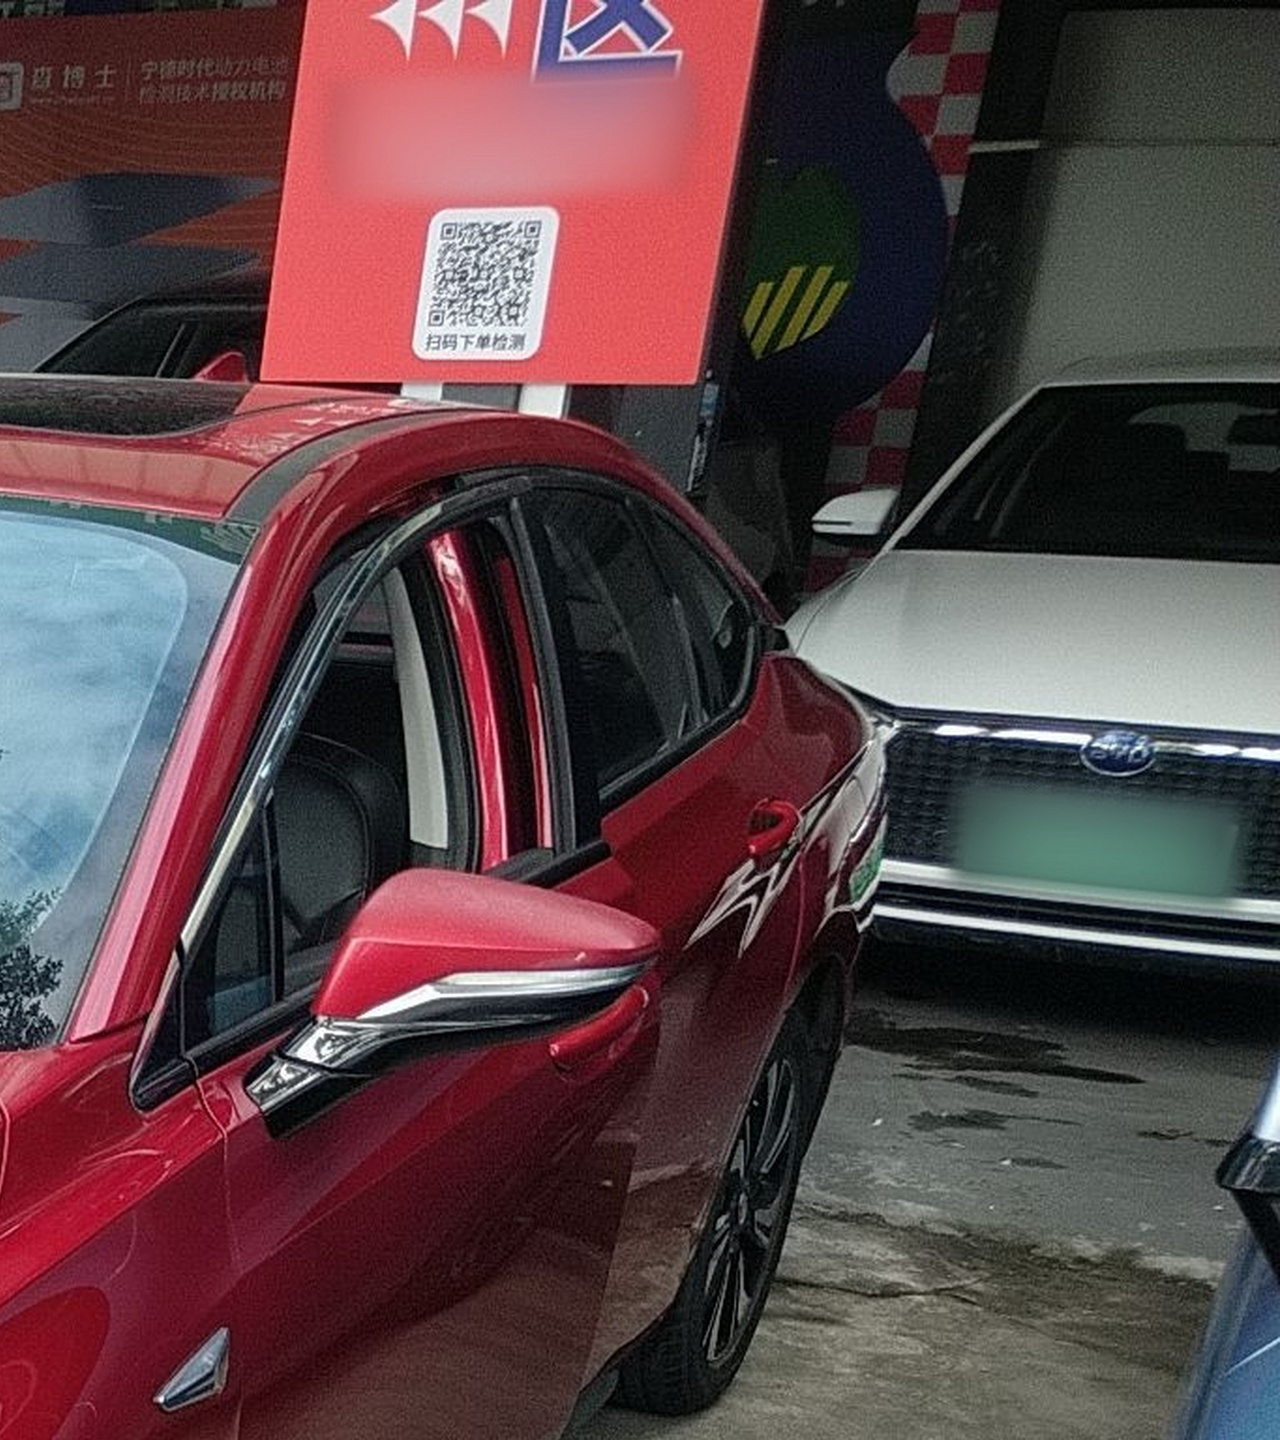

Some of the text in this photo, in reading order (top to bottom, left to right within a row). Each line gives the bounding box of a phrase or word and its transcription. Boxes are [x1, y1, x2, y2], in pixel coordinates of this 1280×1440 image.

[424, 332, 527, 353] 扫码下单检测
